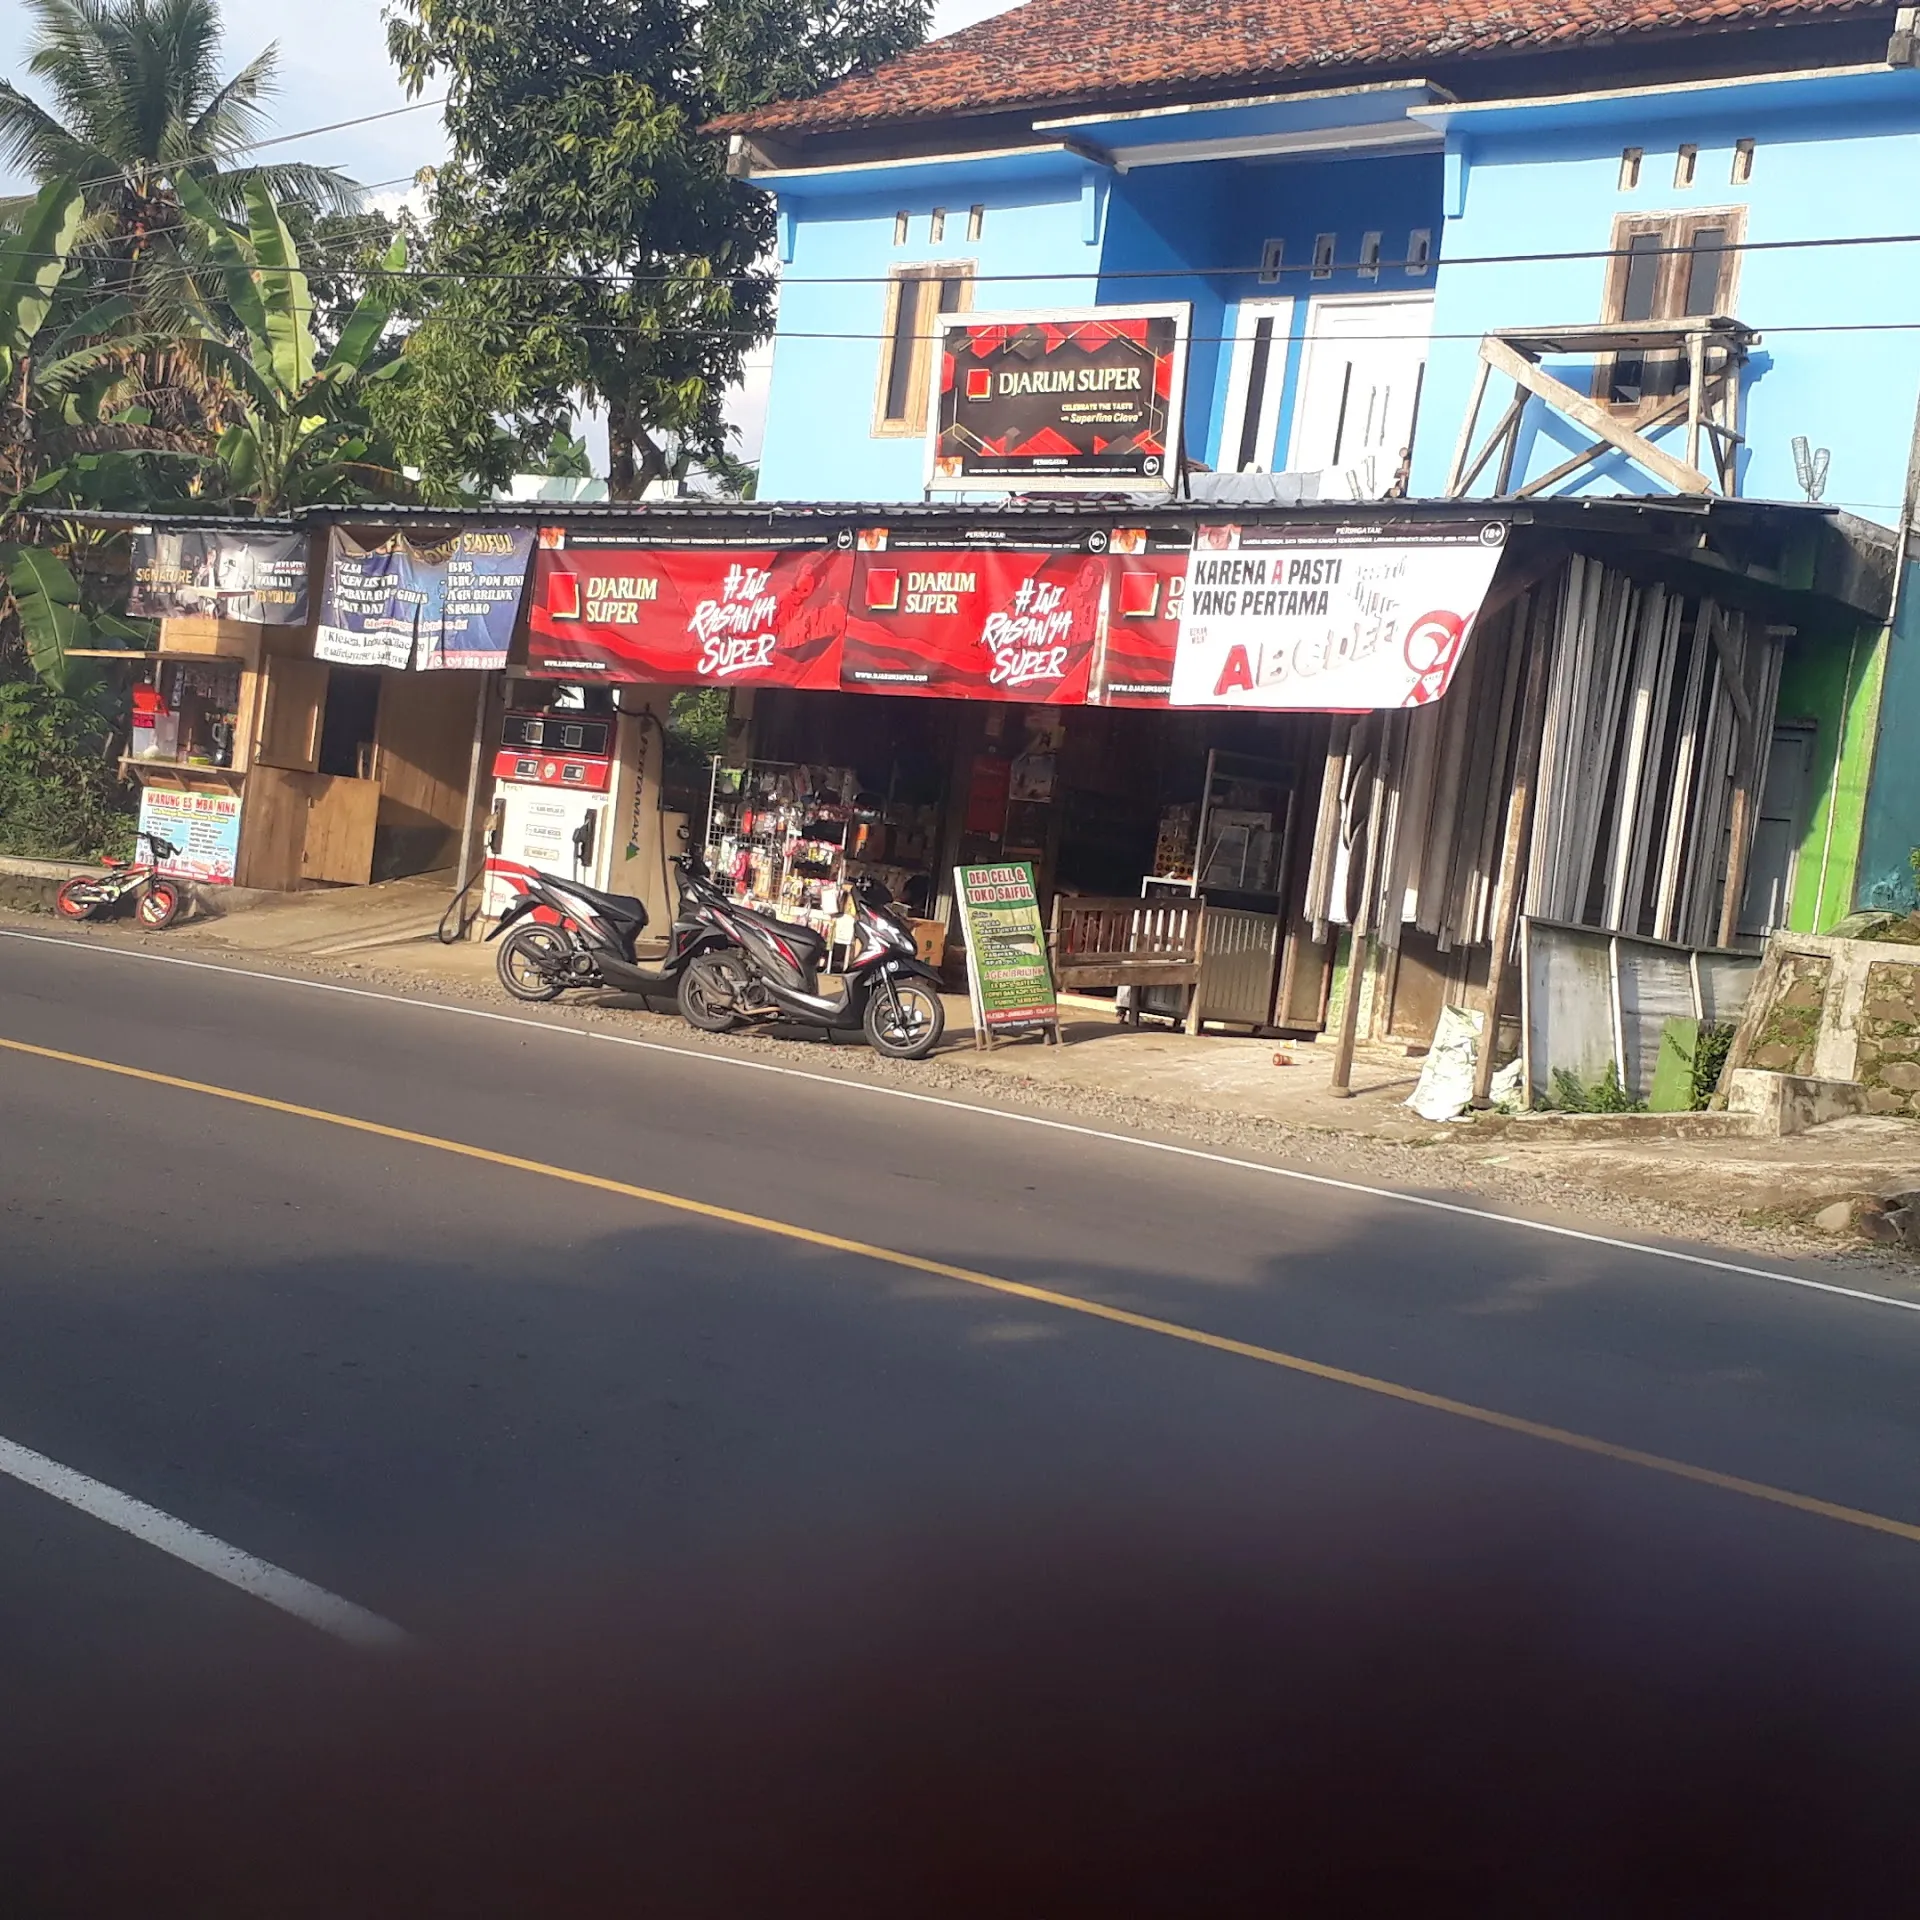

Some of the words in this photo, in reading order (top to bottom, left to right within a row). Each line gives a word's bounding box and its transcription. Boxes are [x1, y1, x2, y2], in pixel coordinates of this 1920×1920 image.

[999, 370, 1075, 397] DJARUM
[1077, 367, 1142, 391] SUPER
[1098, 402, 1111, 410] THE
[1112, 402, 1134, 410] TASTE
[1070, 412, 1113, 424] Superfine
[463, 533, 514, 554] SAIFUL
[1485, 528, 1501, 539] 18+
[136, 568, 193, 584] SIGNATURE
[907, 572, 976, 593] DJARUM
[1195, 559, 1266, 585] KARENA
[1271, 560, 1284, 585] A
[1288, 559, 1343, 585] PASTI
[586, 577, 658, 601] DJARUM
[586, 602, 638, 623] SUPER
[905, 594, 958, 614] SUPER
[1192, 590, 1237, 616] YANG
[1240, 590, 1329, 616] PERTAMA
[687, 595, 777, 642] RASANYA
[981, 611, 1073, 652] RASANYA
[698, 634, 777, 676] SUPER
[990, 646, 1068, 682] SUPER
[147, 792, 180, 806] WARUNG
[183, 797, 193, 808] ES
[216, 801, 236, 814] NINA
[969, 871, 989, 885] DEA
[990, 869, 1014, 884] CELL
[1016, 868, 1026, 881] &
[968, 888, 995, 902] TOKO
[997, 886, 1032, 900] SAIFUL
[984, 970, 1009, 980] AGEN
